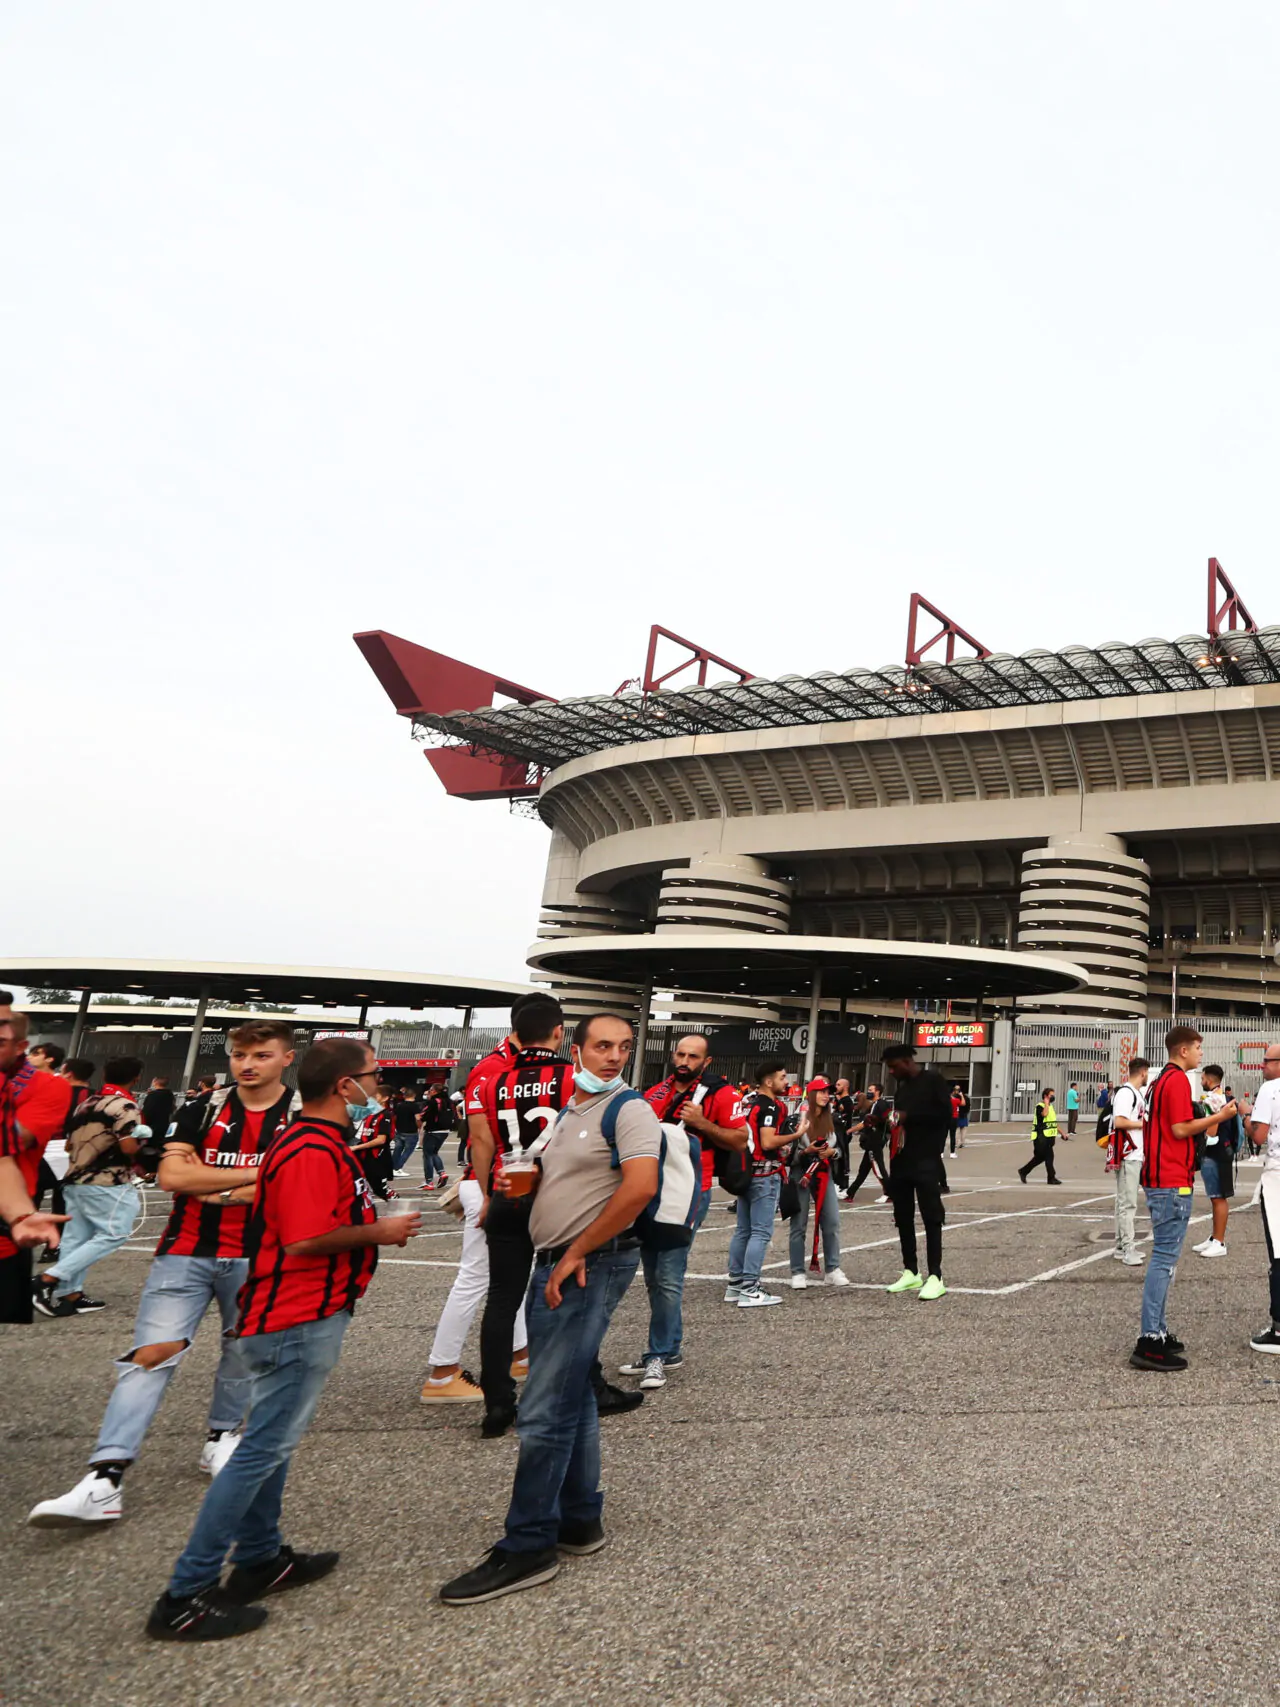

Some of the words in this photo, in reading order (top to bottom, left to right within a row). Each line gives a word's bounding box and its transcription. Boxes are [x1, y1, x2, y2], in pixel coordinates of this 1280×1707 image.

[750, 1028, 791, 1040] INGRESSO
[918, 1026, 945, 1034] STAFF
[947, 1026, 954, 1034] &
[956, 1026, 983, 1034] MEDIA
[759, 1040, 780, 1051] GATE
[926, 1036, 973, 1044] ENTRANCE
[498, 1078, 557, 1100] A.REBIĆ
[498, 1106, 560, 1157] 12
